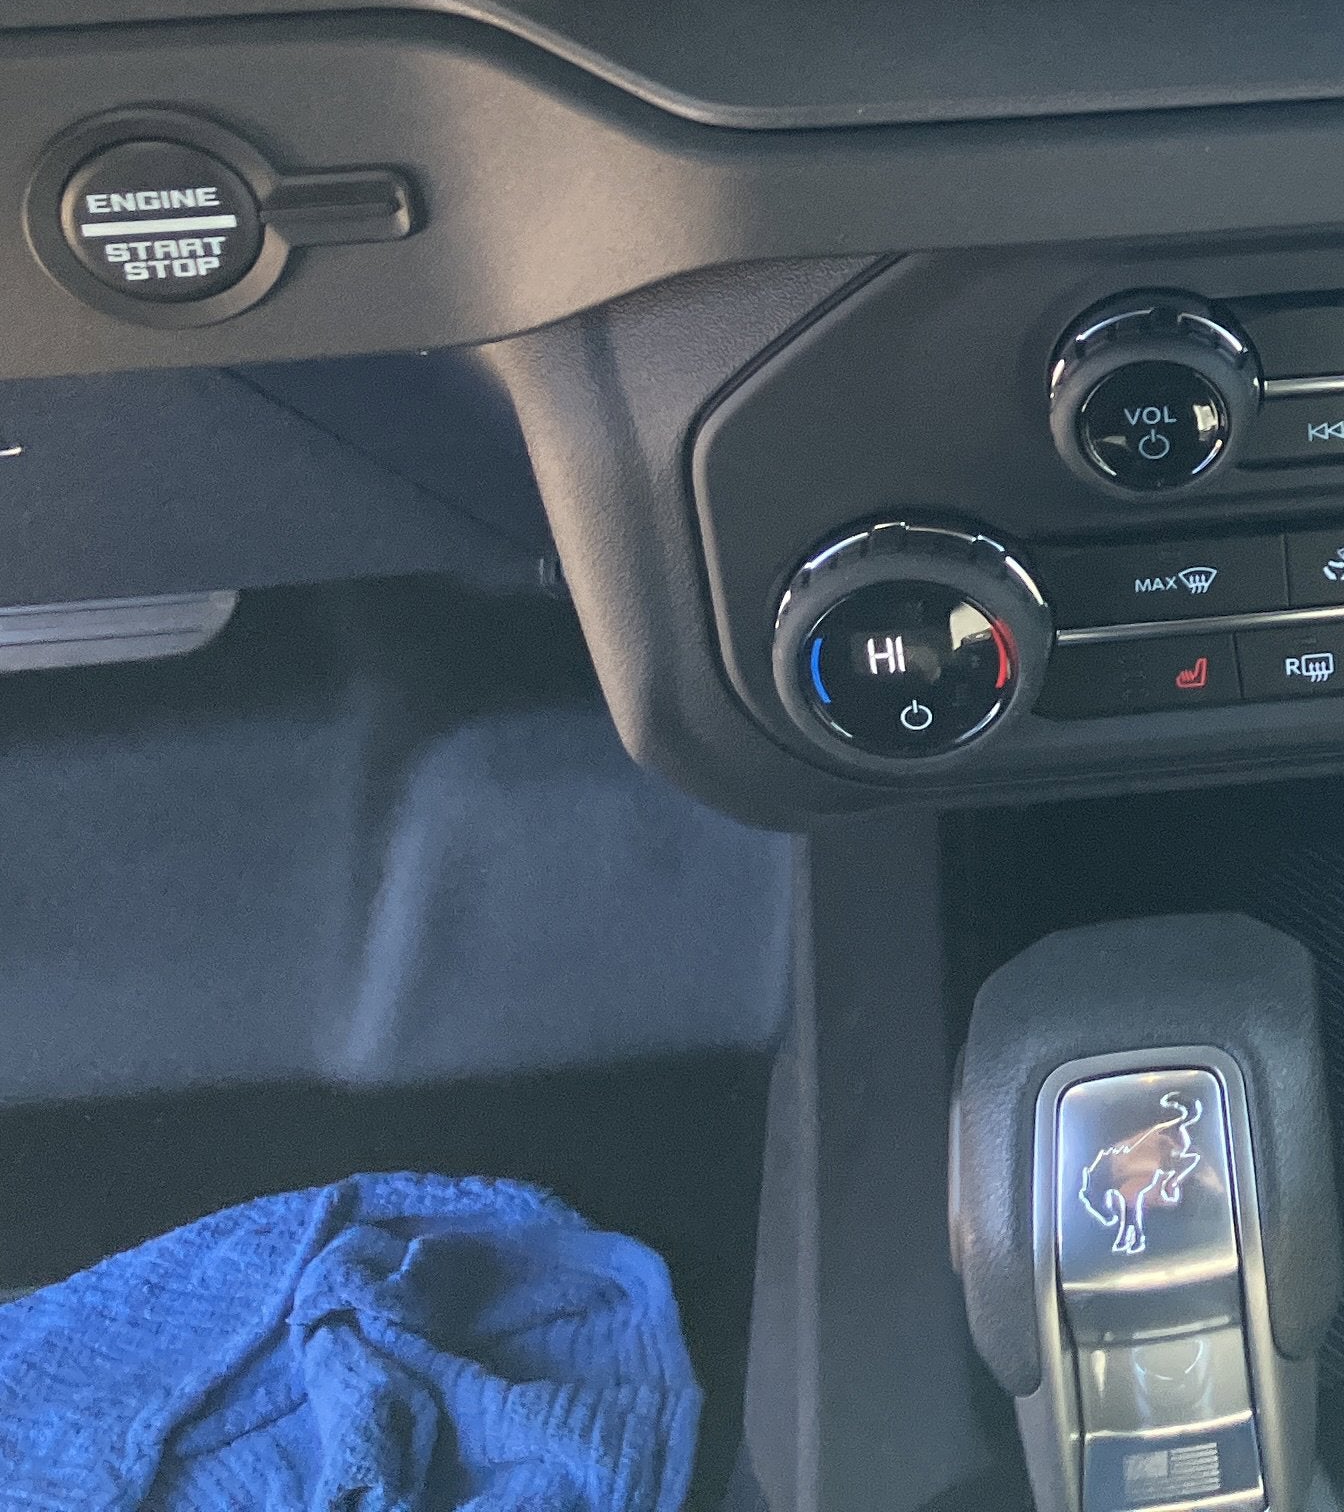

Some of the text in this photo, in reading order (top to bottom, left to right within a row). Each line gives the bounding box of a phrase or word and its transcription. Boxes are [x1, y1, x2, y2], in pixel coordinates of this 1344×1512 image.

[85, 187, 220, 214] ENGINE
[105, 236, 227, 263] START
[123, 256, 221, 282] STOP
[1124, 406, 1178, 425] VOL
[1135, 575, 1178, 594] MAX
[867, 635, 906, 675] HI
